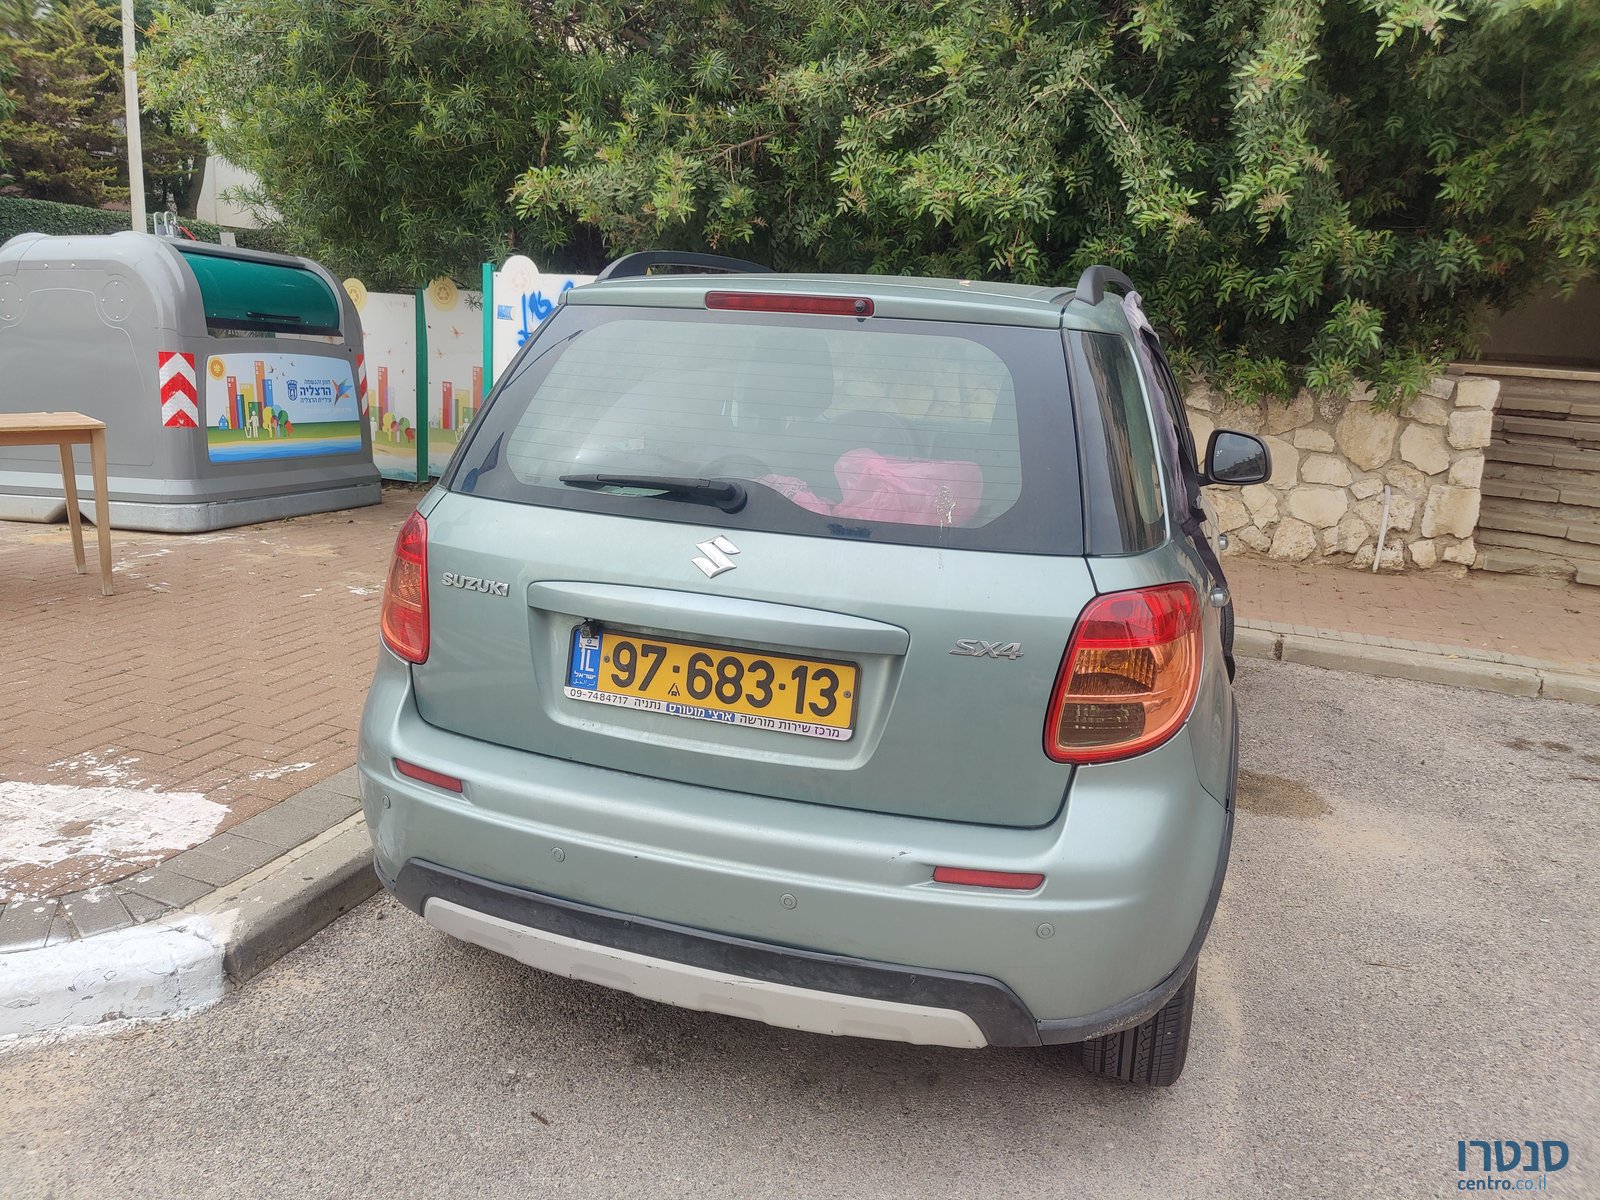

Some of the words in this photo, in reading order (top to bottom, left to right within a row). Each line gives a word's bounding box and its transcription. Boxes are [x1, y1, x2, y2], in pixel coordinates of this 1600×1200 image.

[300, 385, 331, 396] הרצליה
[441, 571, 509, 597] SUZUKI
[948, 639, 1024, 660] SX4
[573, 670, 597, 680] ישראל
[570, 688, 629, 705] 09-7484717
[634, 698, 661, 710] נתניה
[668, 704, 705, 718] מוטורס
[708, 709, 733, 722] ארצי
[739, 714, 775, 728] מורשה
[778, 719, 811, 734] שירות
[814, 725, 840, 738] מרכז
